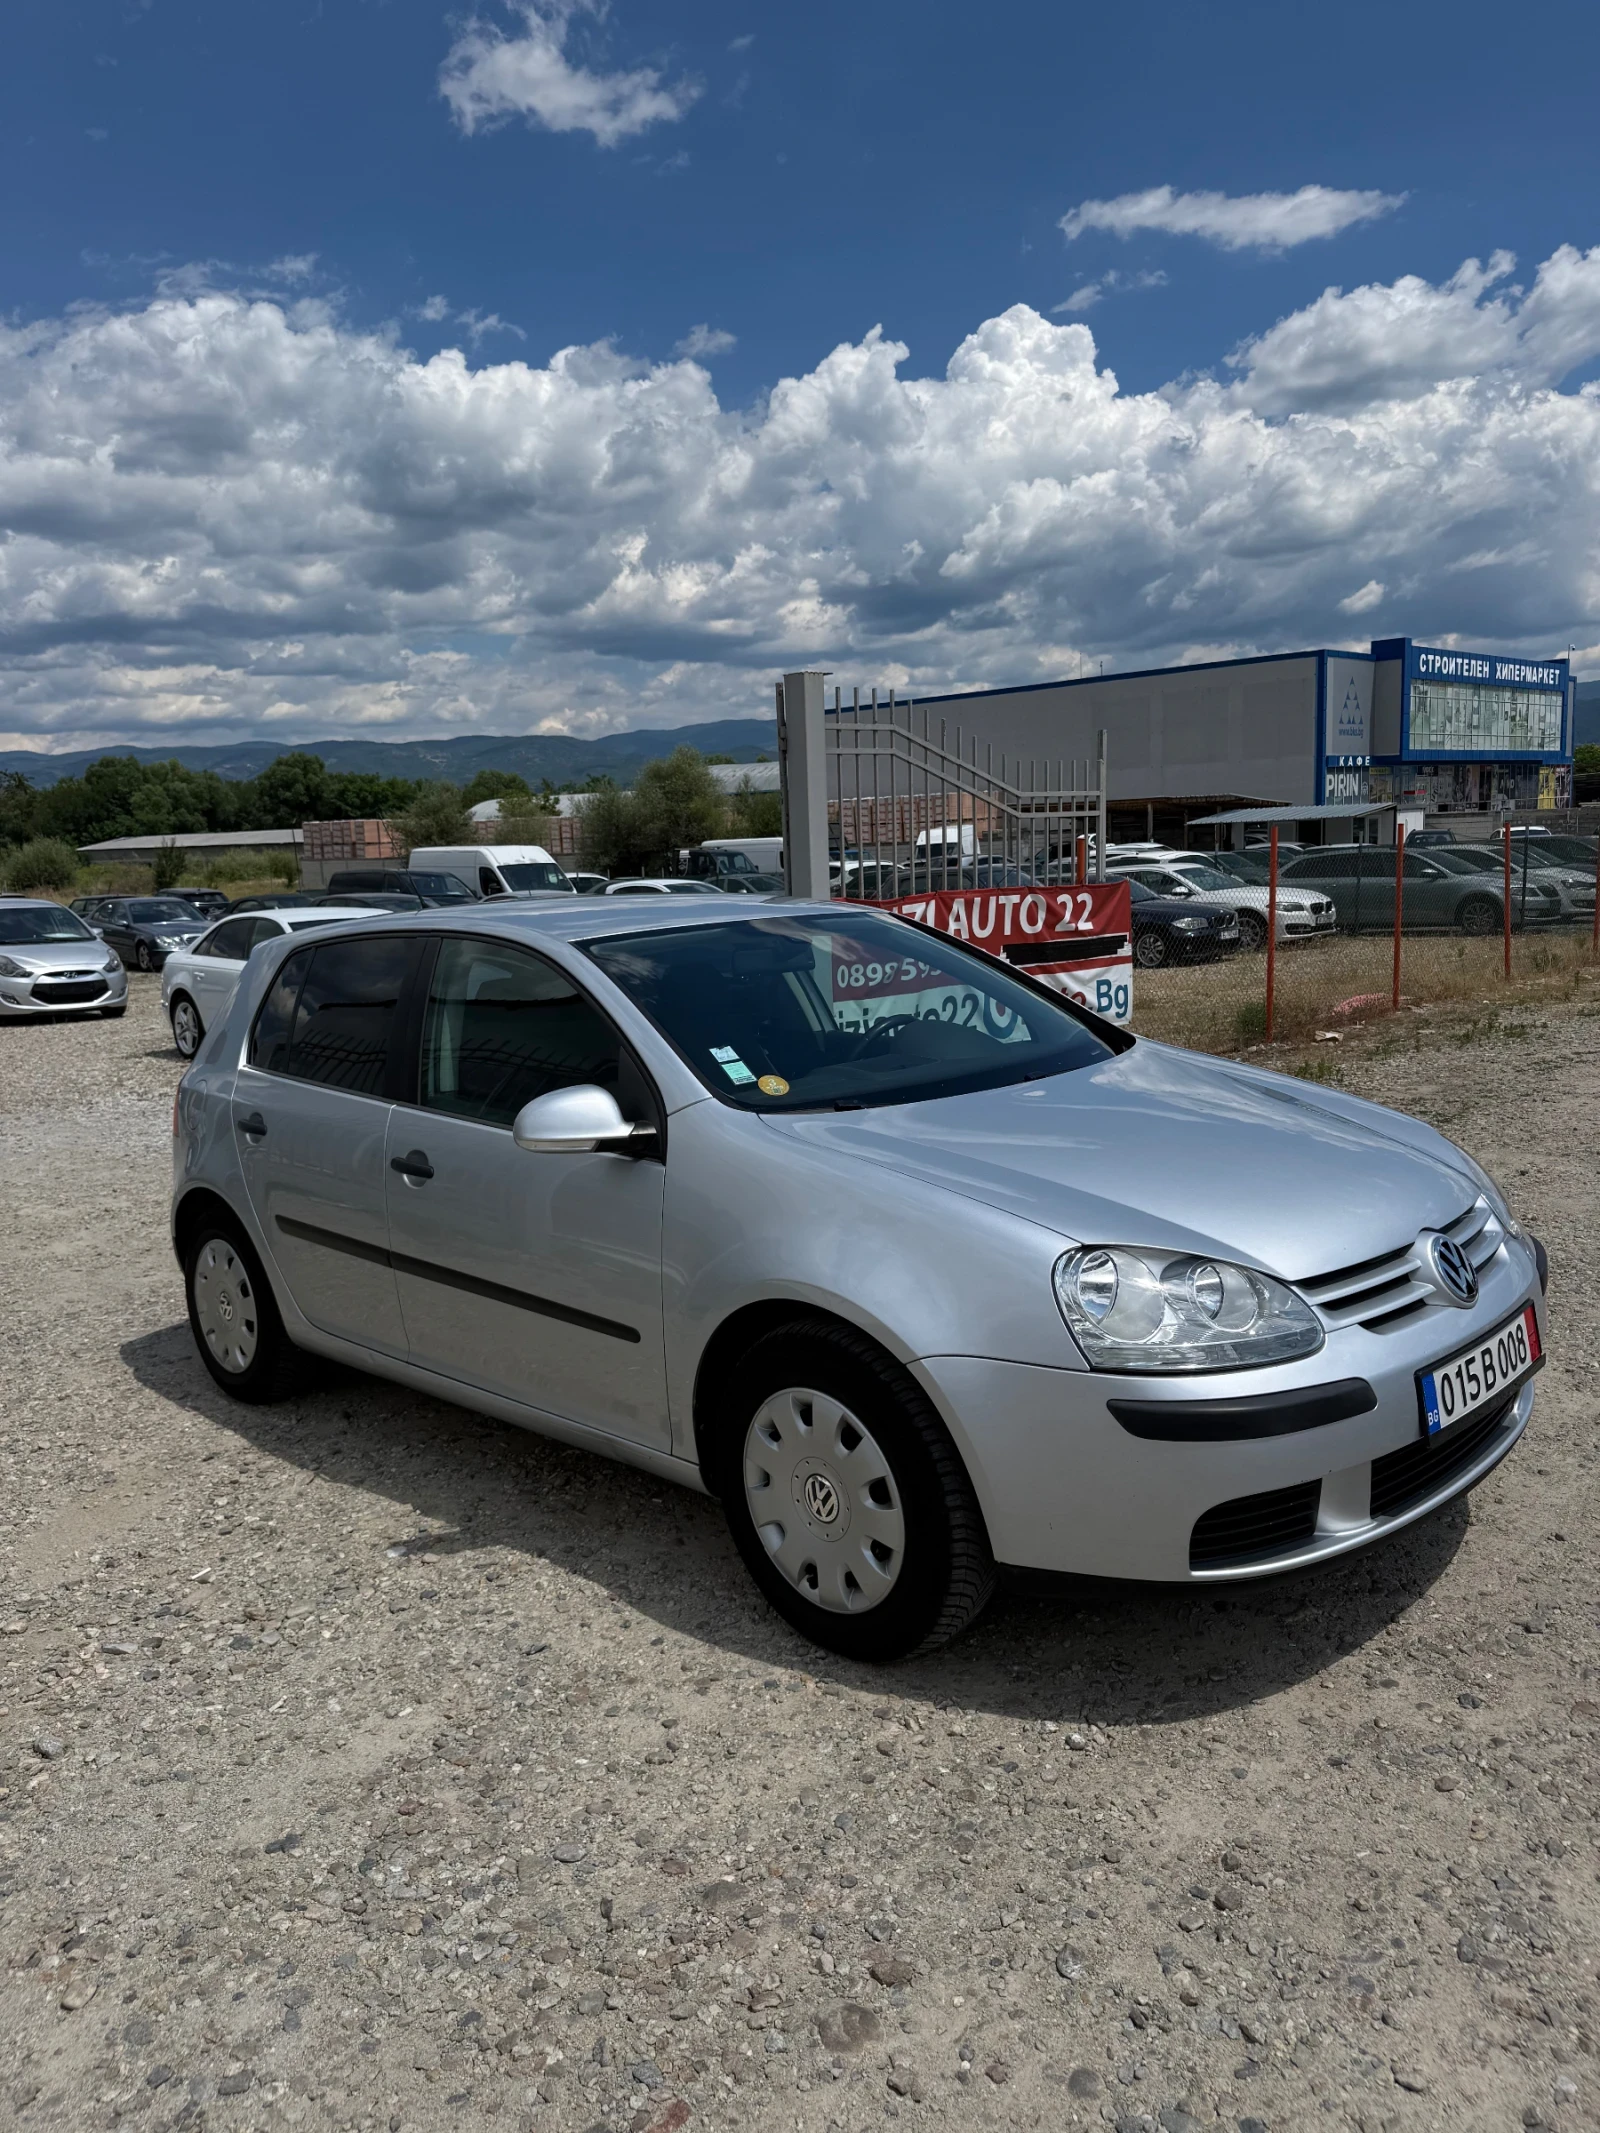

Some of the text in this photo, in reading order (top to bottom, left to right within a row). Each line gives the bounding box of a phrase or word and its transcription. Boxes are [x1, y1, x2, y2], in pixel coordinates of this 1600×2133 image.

[1419, 653, 1561, 685] СТРОИТЕЛЕН ХИПЕРМАРКЕТ
[1339, 756, 1371, 766] КАФЕ
[1326, 773, 1359, 797] PIRIN
[893, 892, 1094, 939] ZI AUTO 22
[1427, 1409, 1439, 1426] BG
